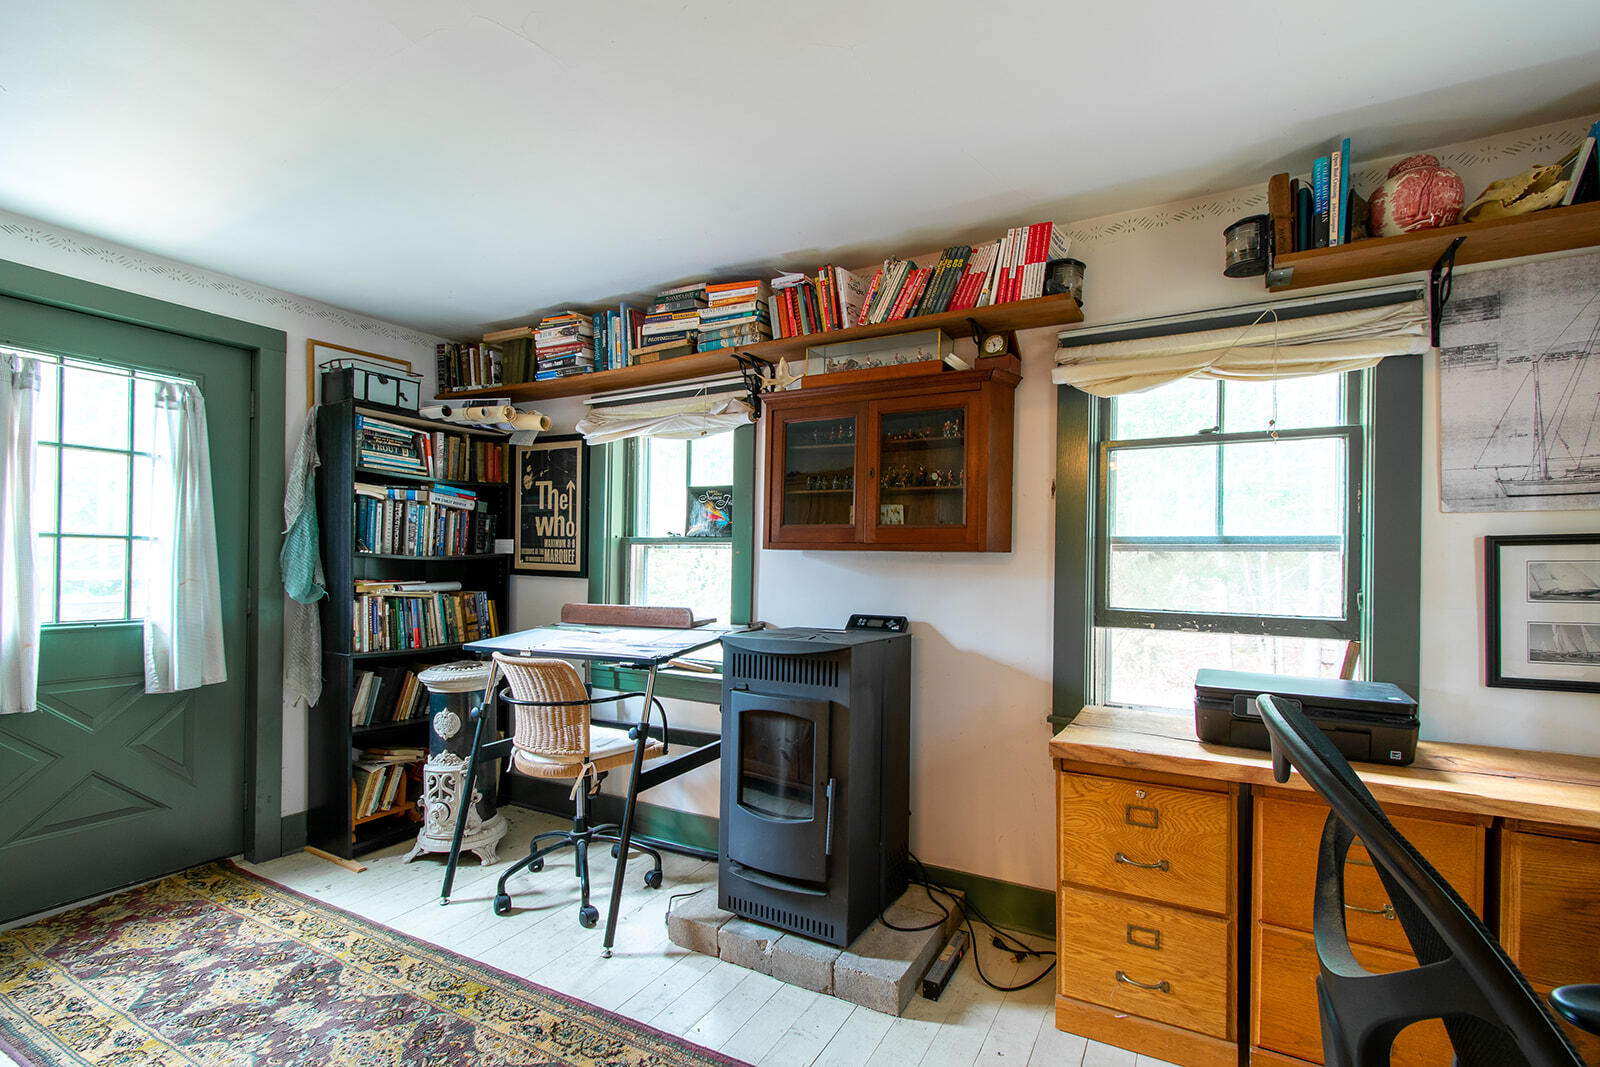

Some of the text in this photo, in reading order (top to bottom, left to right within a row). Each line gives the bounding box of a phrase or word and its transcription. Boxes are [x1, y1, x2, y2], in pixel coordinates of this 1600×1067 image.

[1321, 184, 1329, 223] MOUNTAIN
[535, 481, 569, 510] The
[544, 549, 575, 564] MARQUEE
